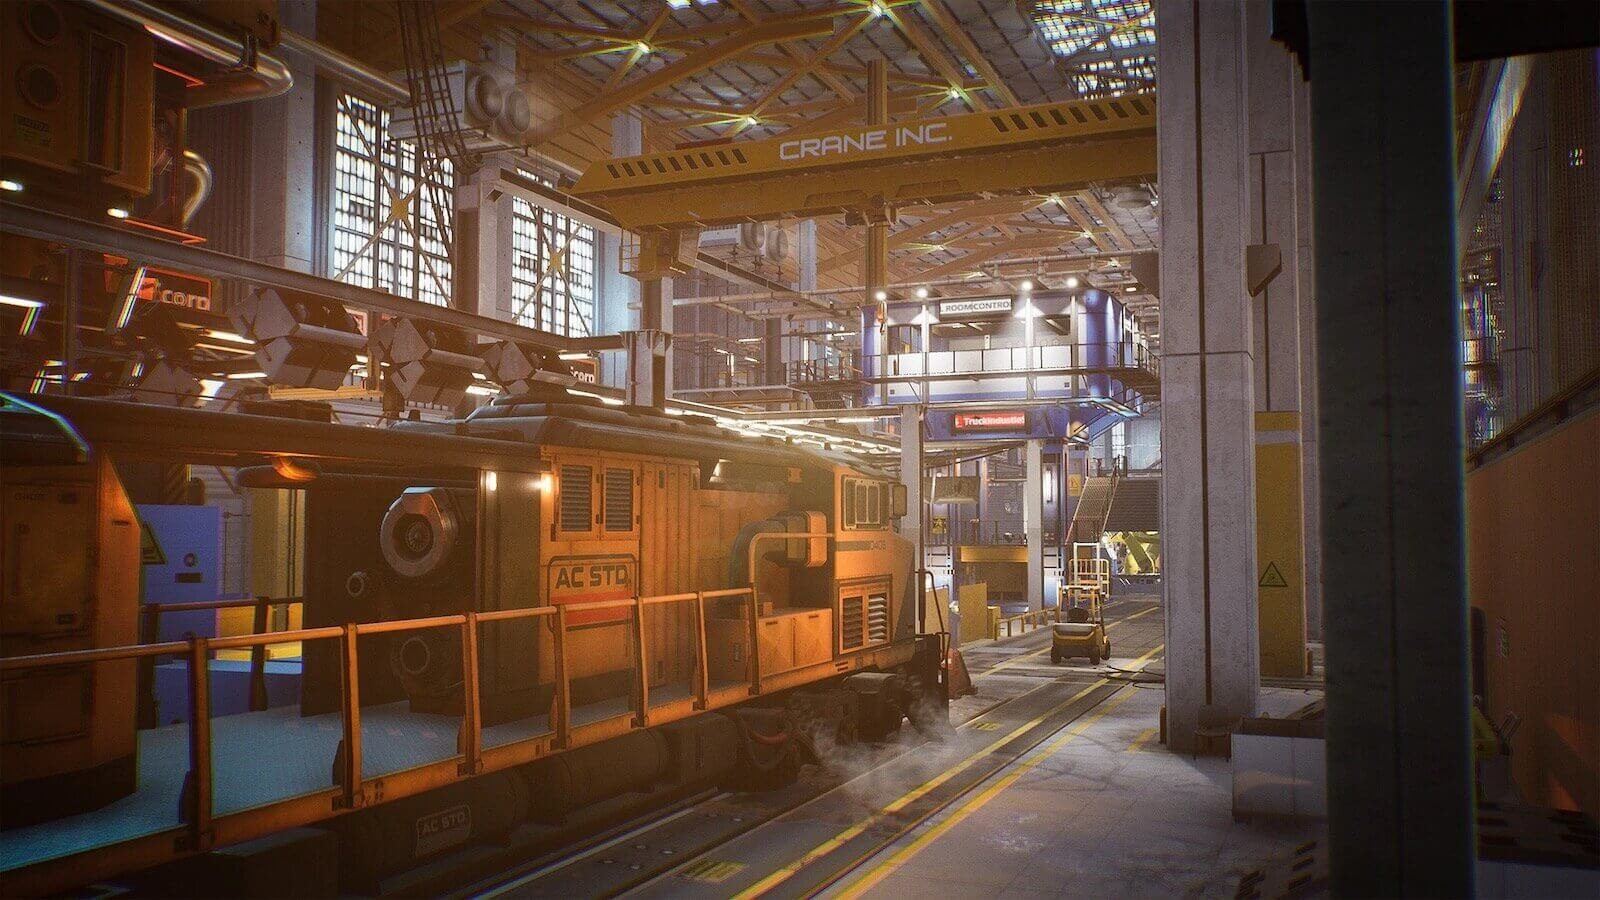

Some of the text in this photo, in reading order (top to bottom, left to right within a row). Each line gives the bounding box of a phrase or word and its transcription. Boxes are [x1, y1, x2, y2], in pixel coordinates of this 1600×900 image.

[779, 122, 953, 161] CRANE INC.
[555, 566, 584, 589] AC
